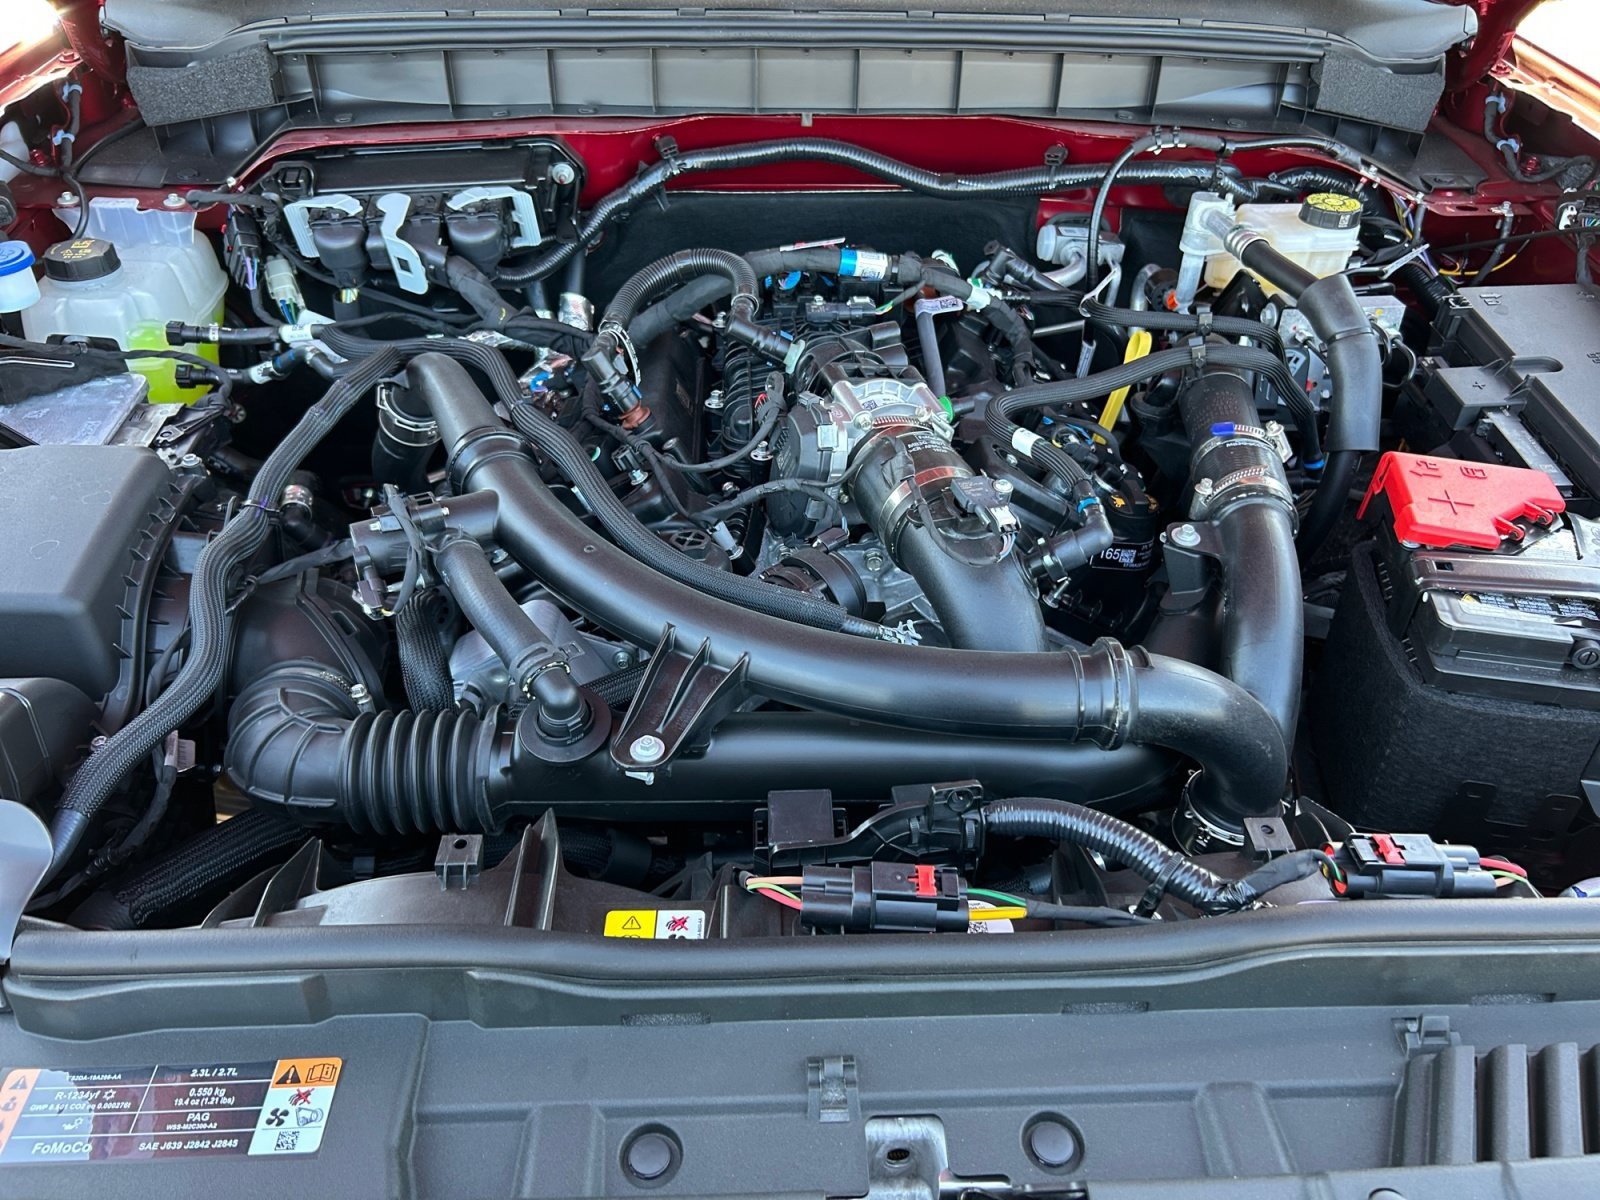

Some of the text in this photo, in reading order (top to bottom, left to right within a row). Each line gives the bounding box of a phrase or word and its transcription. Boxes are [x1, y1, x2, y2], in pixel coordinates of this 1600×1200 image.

[190, 1068, 210, 1077] 2.3L
[218, 1067, 238, 1076] 2.7L
[55, 1090, 101, 1100] R-1234yf
[189, 1087, 226, 1097] 0.550 kg
[174, 1098, 189, 1106] 19.4
[200, 1097, 219, 1107] (1.21
[220, 1096, 235, 1105] lbs)
[186, 1113, 210, 1121] PAG
[31, 1142, 93, 1154] FoMoCo
[138, 1139, 239, 1151] SAE J639 J2842 J2845
